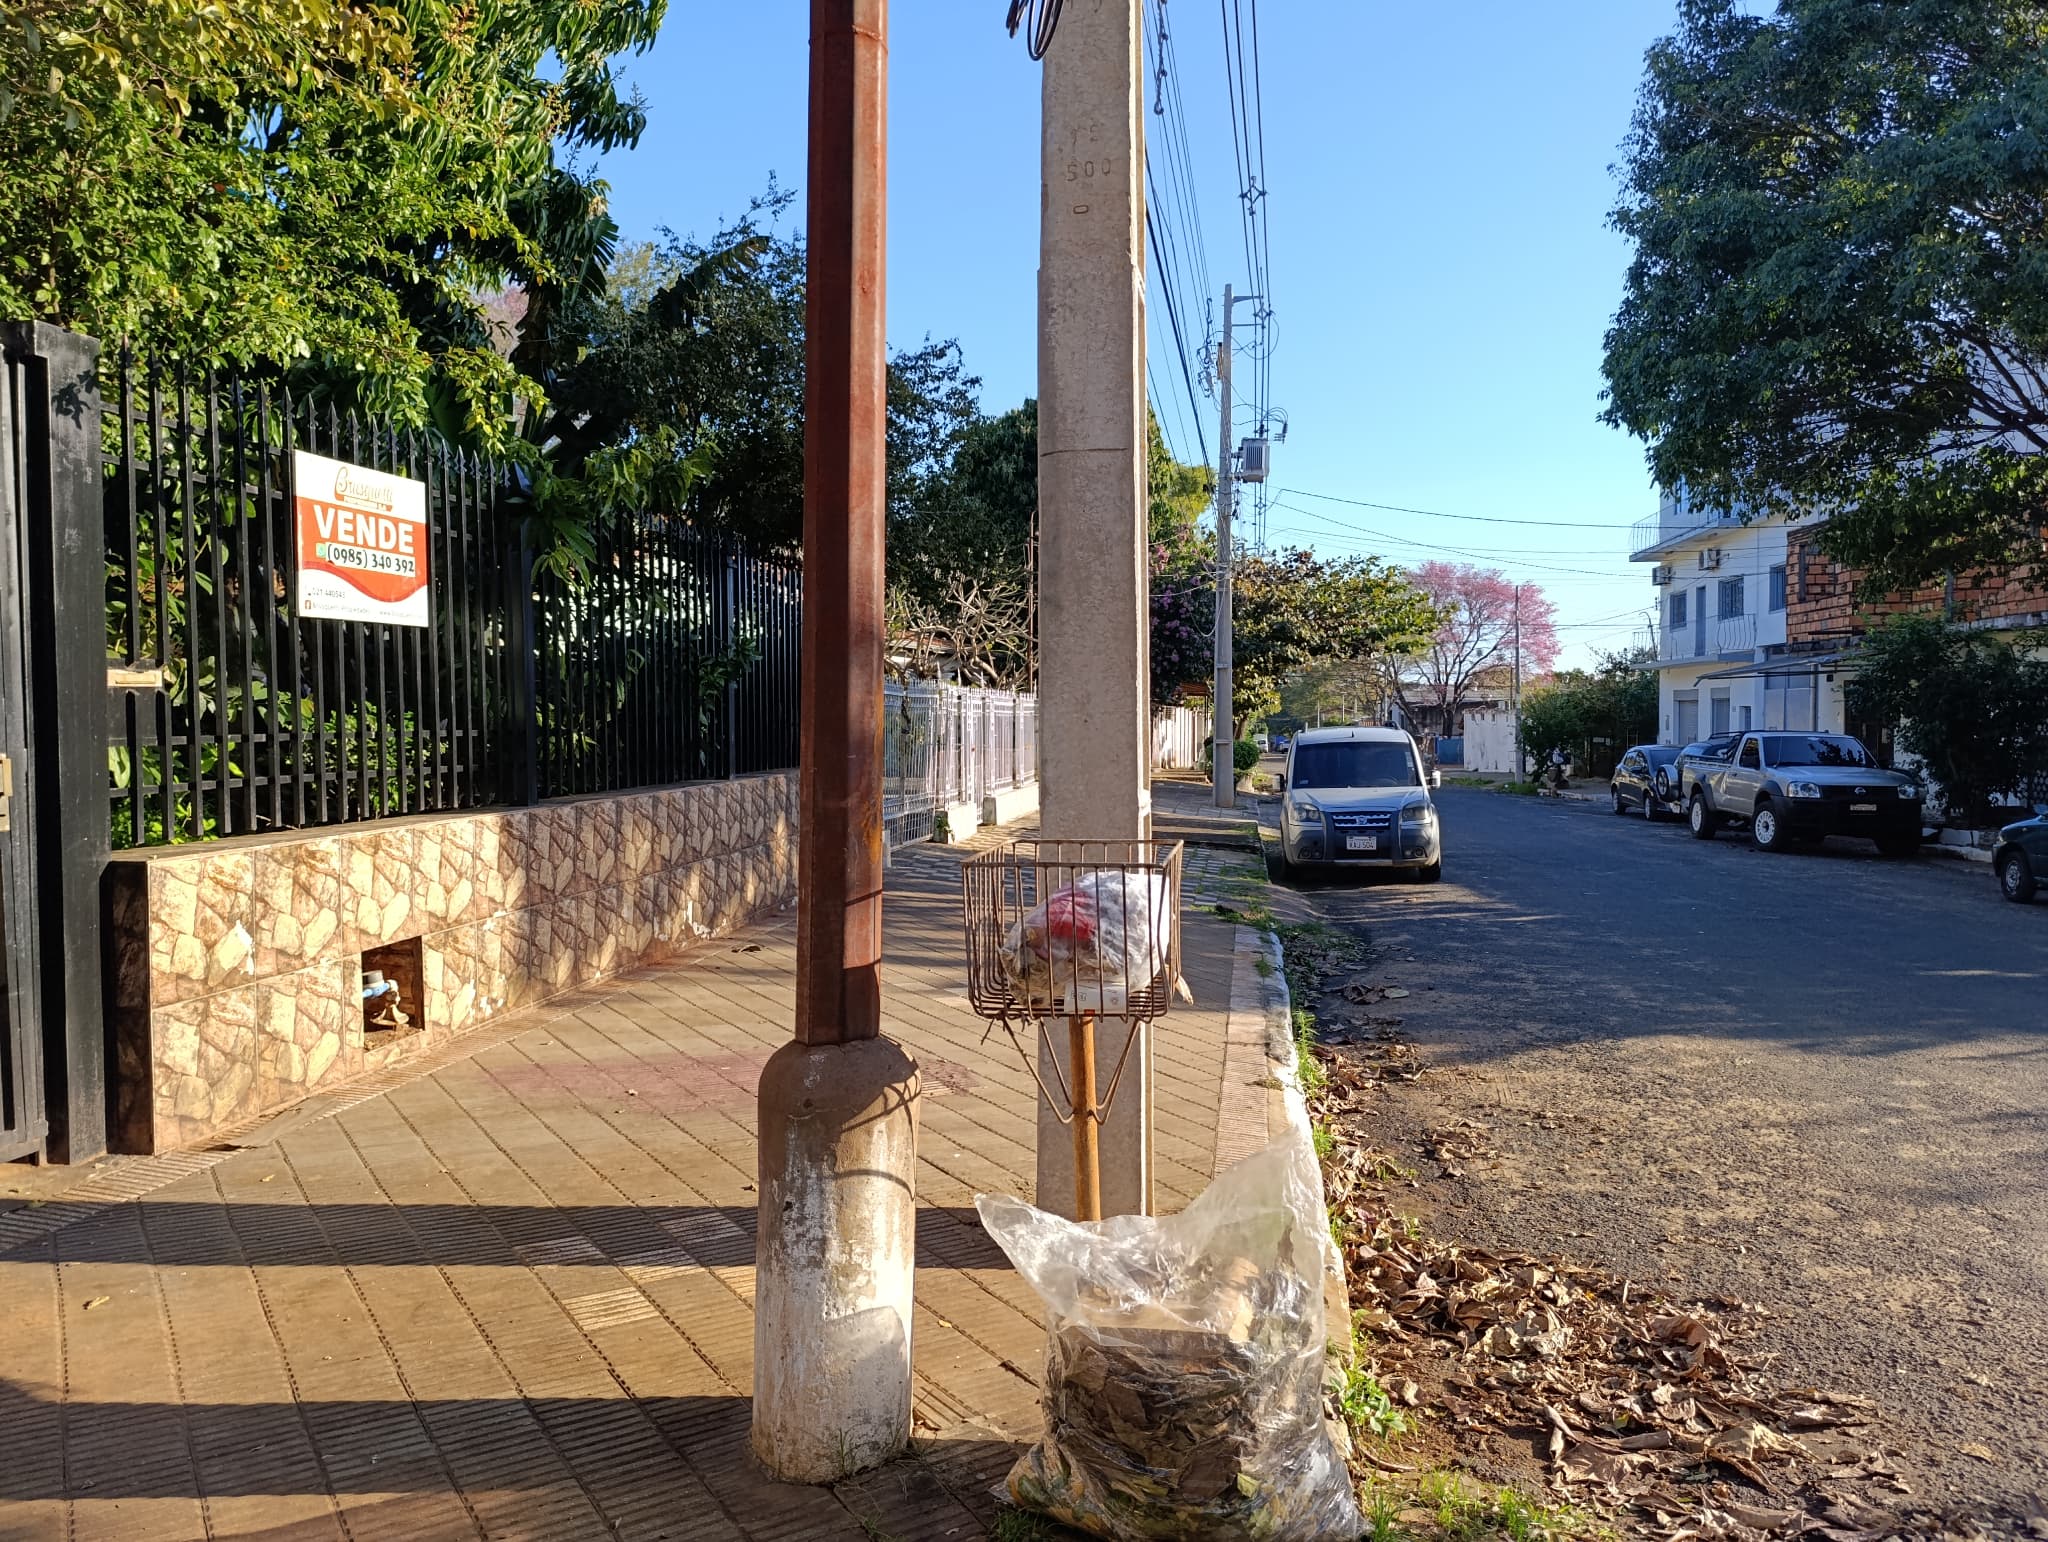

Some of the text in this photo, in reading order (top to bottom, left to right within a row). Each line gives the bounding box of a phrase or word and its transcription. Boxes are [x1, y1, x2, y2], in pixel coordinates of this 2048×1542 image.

[1066, 158, 1111, 182] 500
[313, 504, 414, 554] VENDE
[327, 543, 415, 573] (0985) 340 392
